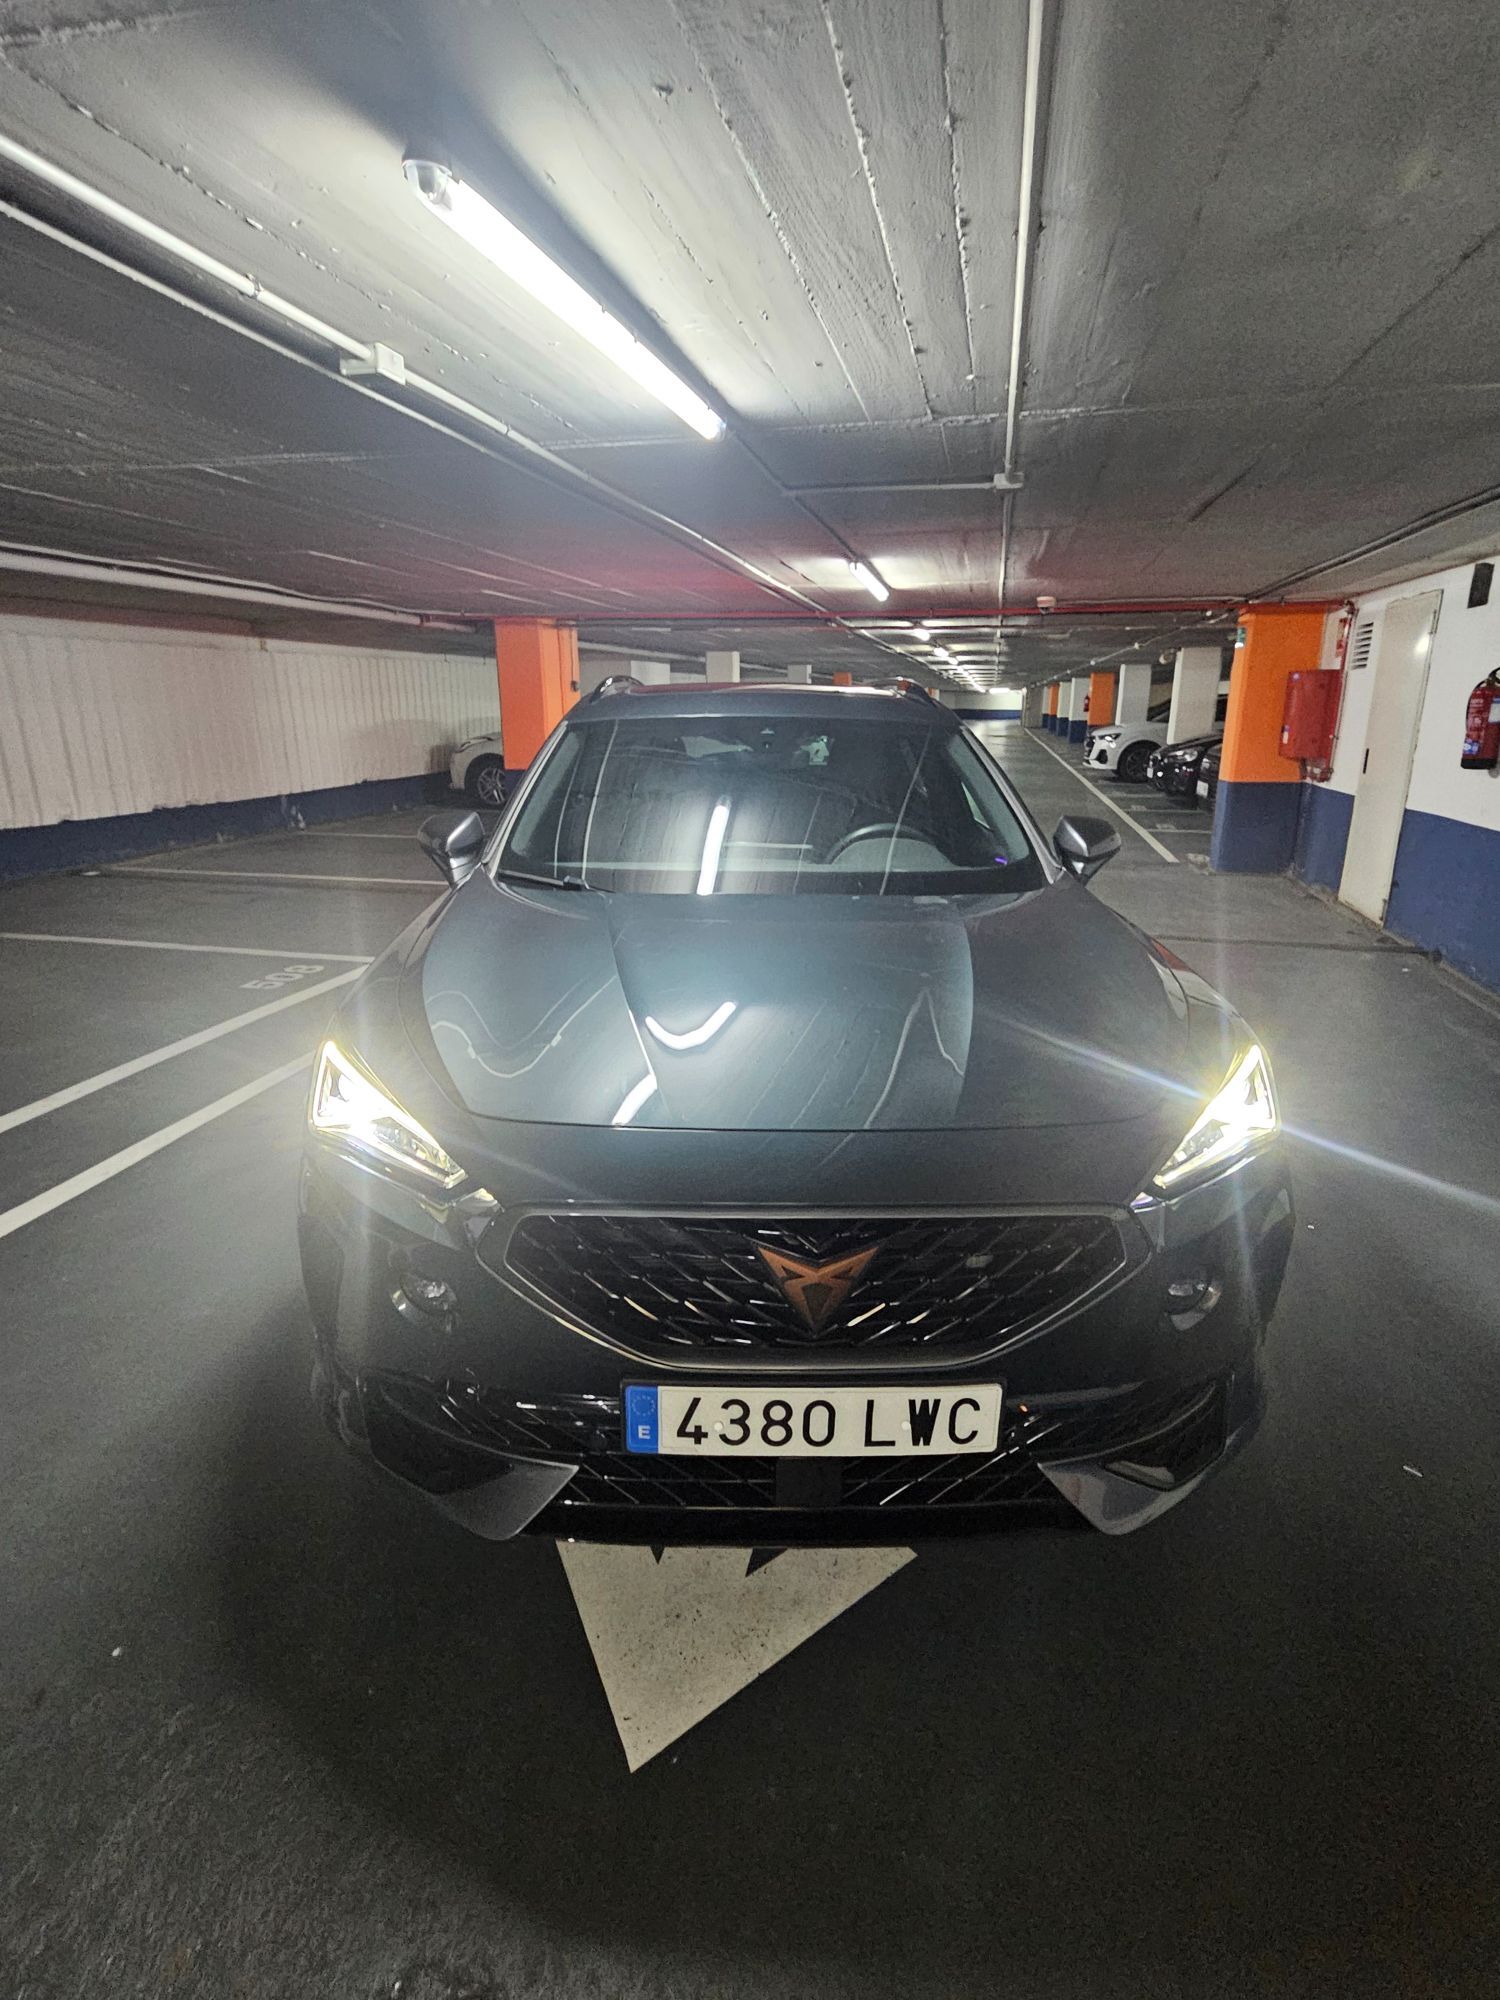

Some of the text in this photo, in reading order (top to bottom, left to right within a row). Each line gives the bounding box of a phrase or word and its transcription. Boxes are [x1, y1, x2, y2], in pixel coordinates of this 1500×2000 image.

[240, 964, 325, 990] 508
[637, 1424, 651, 1440] E
[676, 1396, 981, 1448] 4380 LWC
